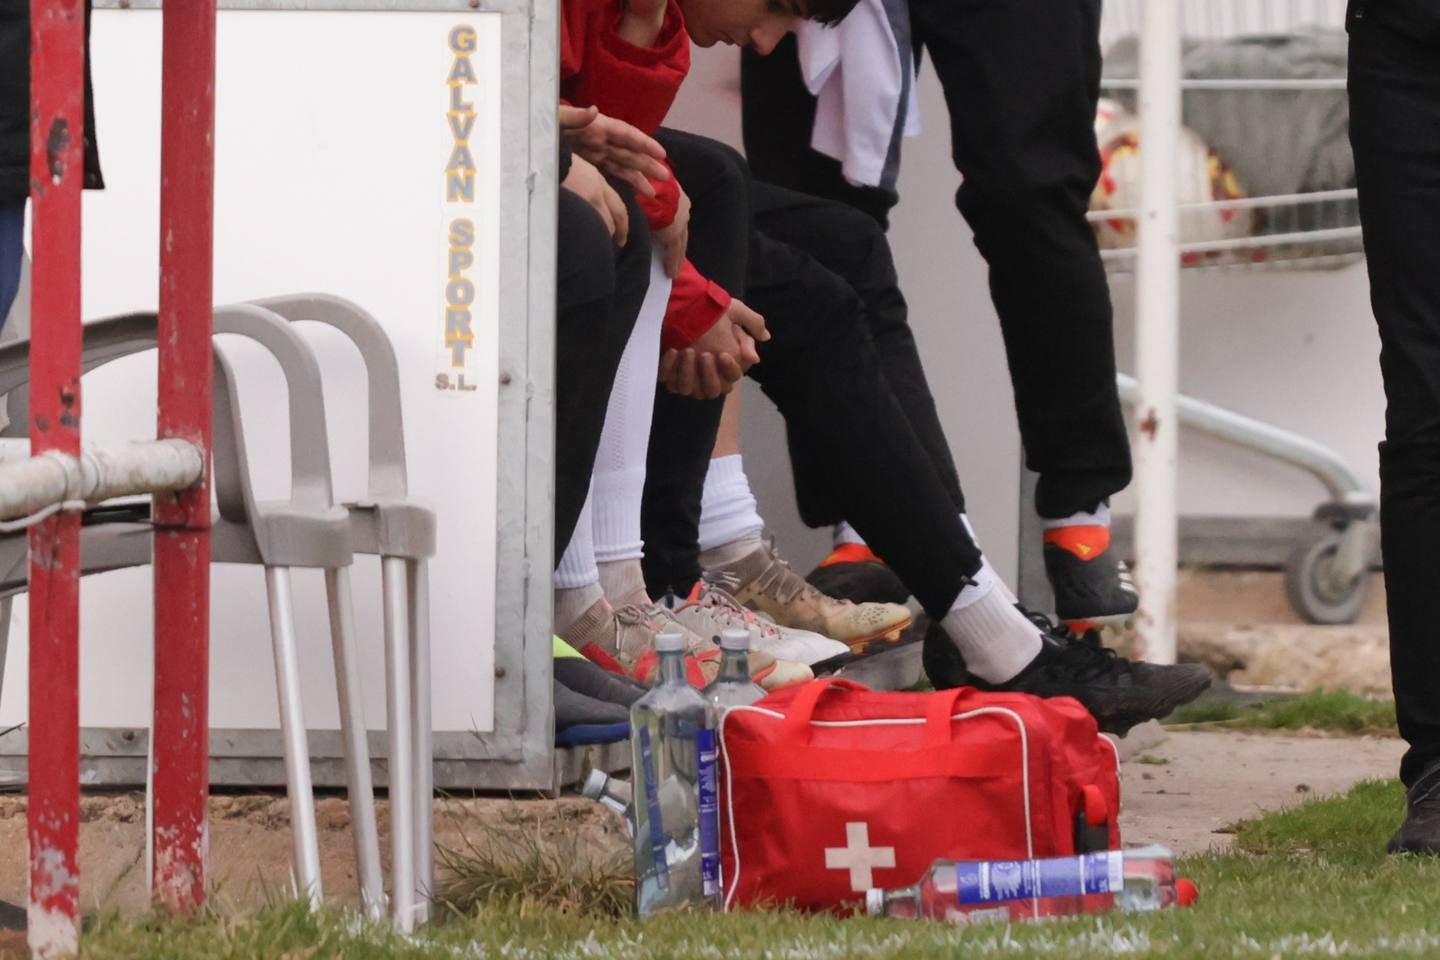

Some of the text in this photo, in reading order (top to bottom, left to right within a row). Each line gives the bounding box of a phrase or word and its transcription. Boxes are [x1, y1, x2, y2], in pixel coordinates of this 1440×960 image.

[445, 24, 478, 368] GALVAN SPORT
[435, 373, 477, 391] S.L.
